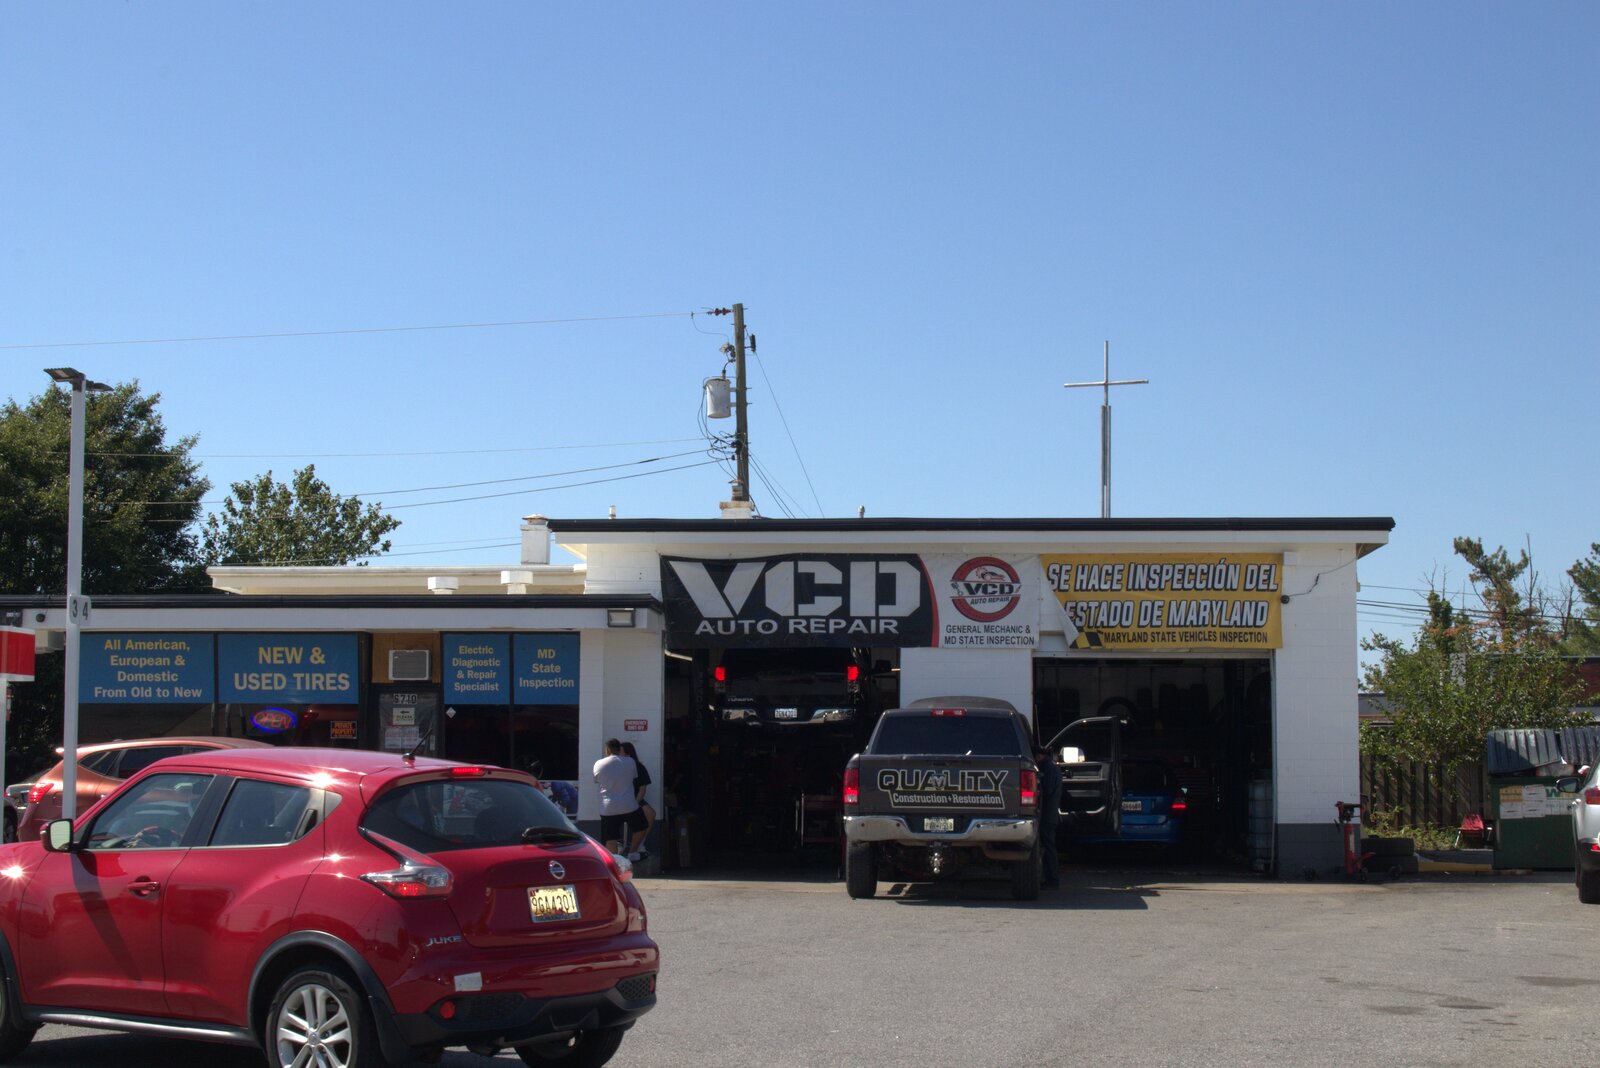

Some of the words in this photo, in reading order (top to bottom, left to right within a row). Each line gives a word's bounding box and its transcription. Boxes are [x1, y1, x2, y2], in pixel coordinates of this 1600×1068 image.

[1049, 563, 1071, 591] SE
[1076, 564, 1123, 591] HACE
[1126, 558, 1241, 591] INSPECCIÓN
[1243, 563, 1279, 591] DEL
[669, 560, 921, 617] VCD
[964, 583, 1014, 596] VCD
[1065, 601, 1136, 628] ESTADO
[1142, 601, 1164, 628] DE
[1167, 601, 1270, 628] MARYLAND
[696, 619, 779, 635] AUTO
[788, 618, 898, 635] REPAIR
[946, 625, 982, 634] GENERAL
[984, 625, 1023, 634] MECHANIC
[1025, 625, 1031, 634] &
[944, 635, 957, 645] MD
[959, 635, 983, 645] STATE
[984, 635, 1035, 645] INSPECTION
[1104, 631, 1149, 643] MARYLAND
[1150, 631, 1175, 643] STATE
[1176, 631, 1218, 643] VEHICLES
[1219, 631, 1268, 643] INSPECTION
[104, 639, 121, 650] All
[125, 639, 190, 652] American,
[458, 645, 494, 655] Electric
[258, 647, 304, 665] NEW
[309, 647, 326, 665] &
[537, 649, 555, 659] MD
[110, 655, 170, 669] European
[174, 656, 186, 666] &
[452, 657, 500, 668] Diagnostic
[532, 663, 561, 673] State
[117, 670, 178, 682] Domestic
[457, 669, 464, 679] &
[467, 669, 497, 680] Repair
[234, 673, 287, 691] USED
[294, 673, 350, 691] TIRES
[454, 681, 499, 692] Specialist
[519, 677, 574, 689] Inspection
[94, 686, 127, 698] From
[131, 686, 153, 698] Old
[156, 687, 170, 698] to
[173, 686, 203, 698] New
[254, 710, 291, 730] OPEN
[878, 768, 1009, 792] QUALITY
[426, 936, 461, 947] JUKE
